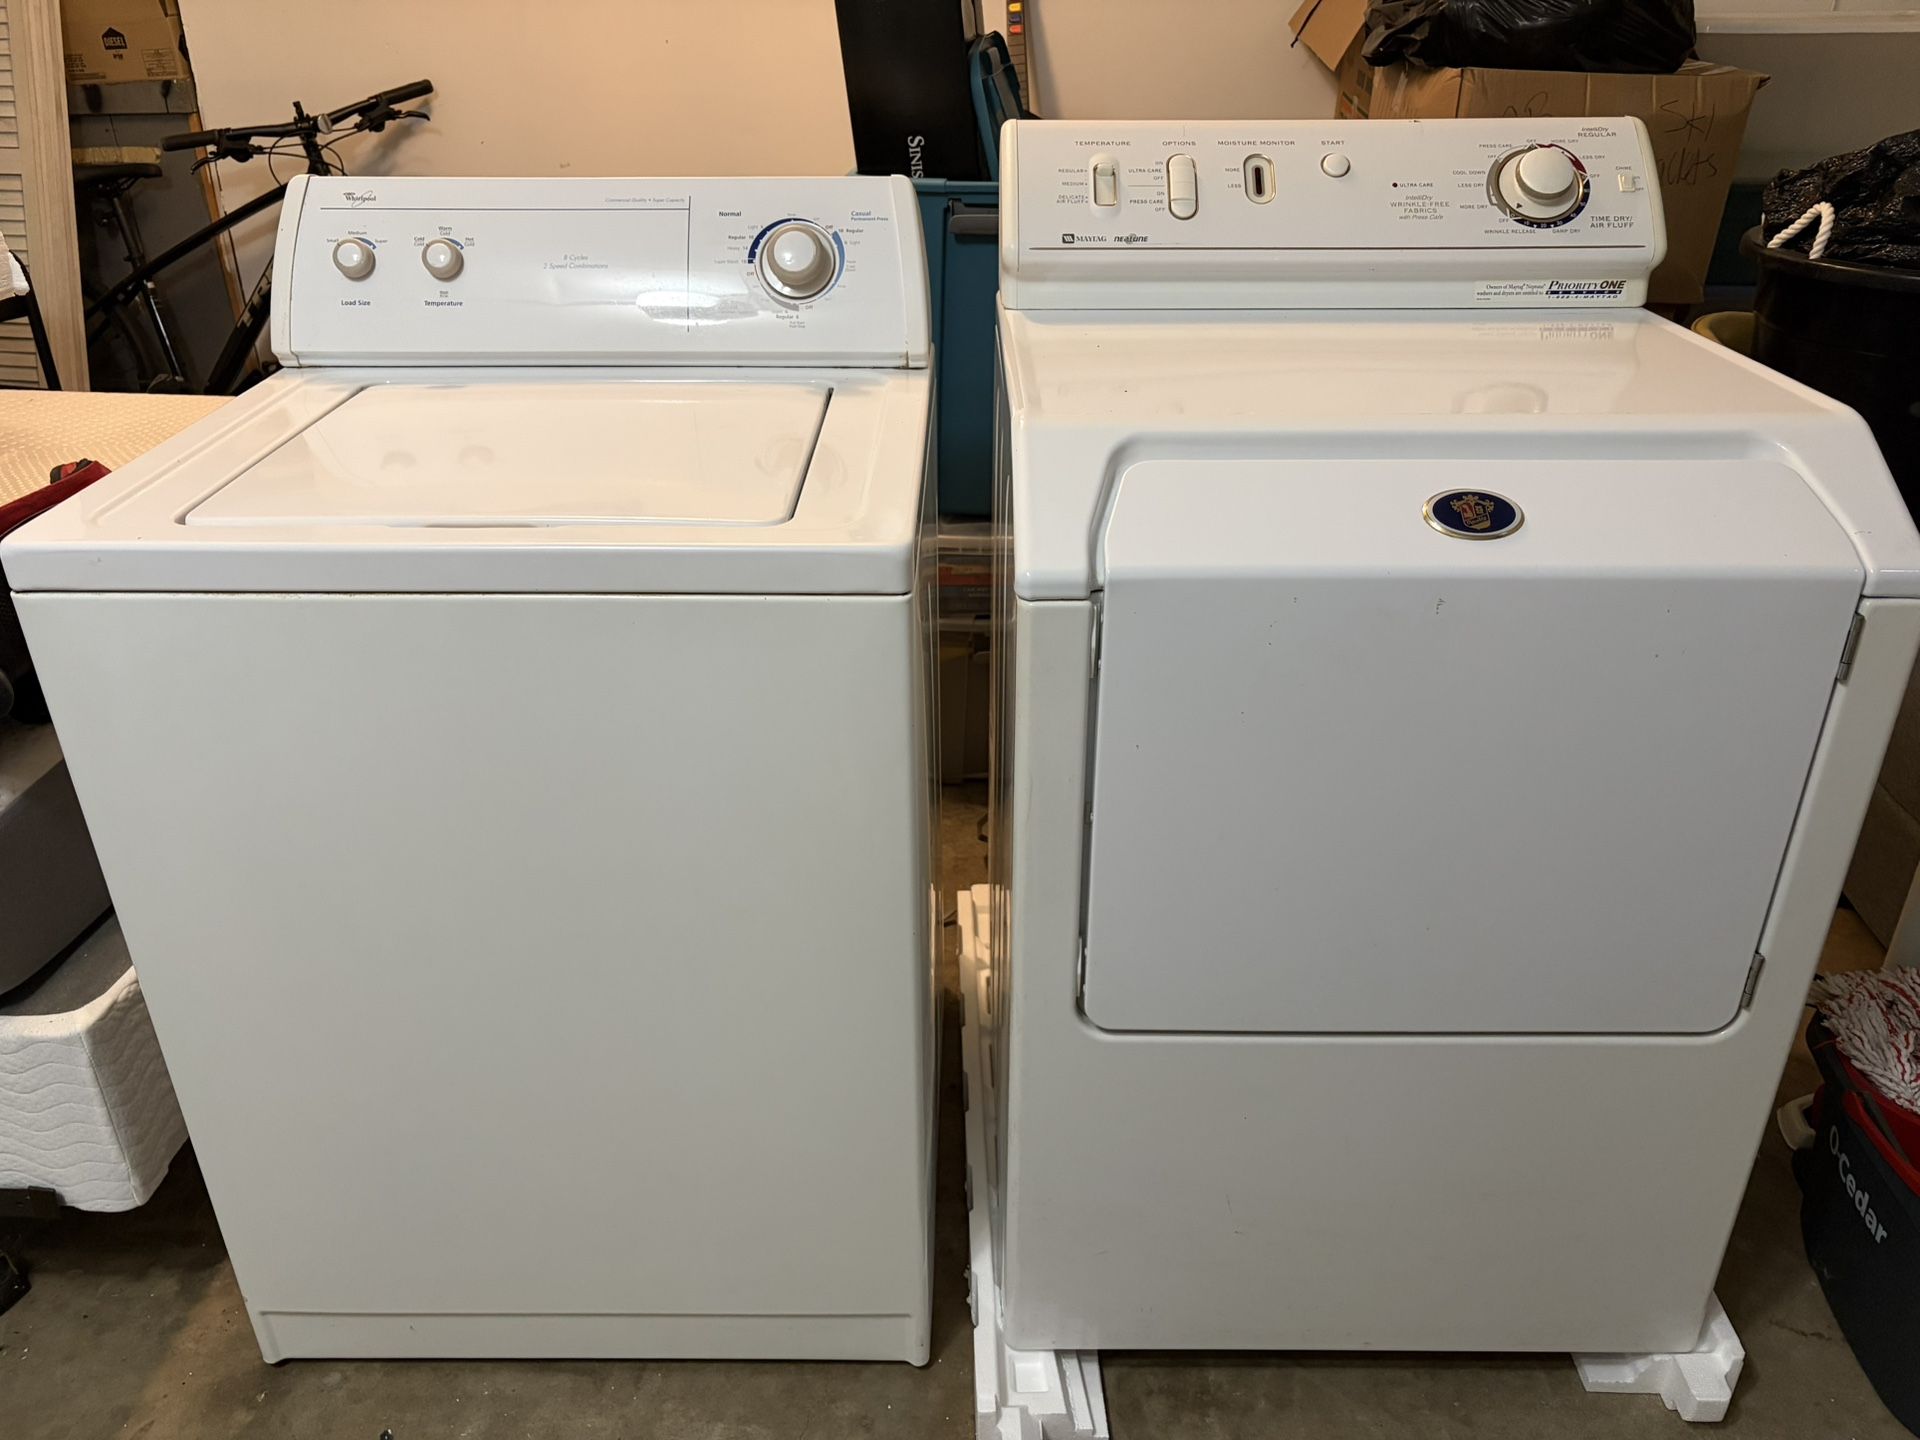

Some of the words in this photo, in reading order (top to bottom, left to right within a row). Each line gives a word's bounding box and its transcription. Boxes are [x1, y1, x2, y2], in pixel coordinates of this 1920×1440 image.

[343, 191, 377, 206] Whirlpool
[569, 254, 589, 262] Cycles
[424, 300, 464, 308] Temperature
[1829, 1124, 1888, 1244] O-Cedar
